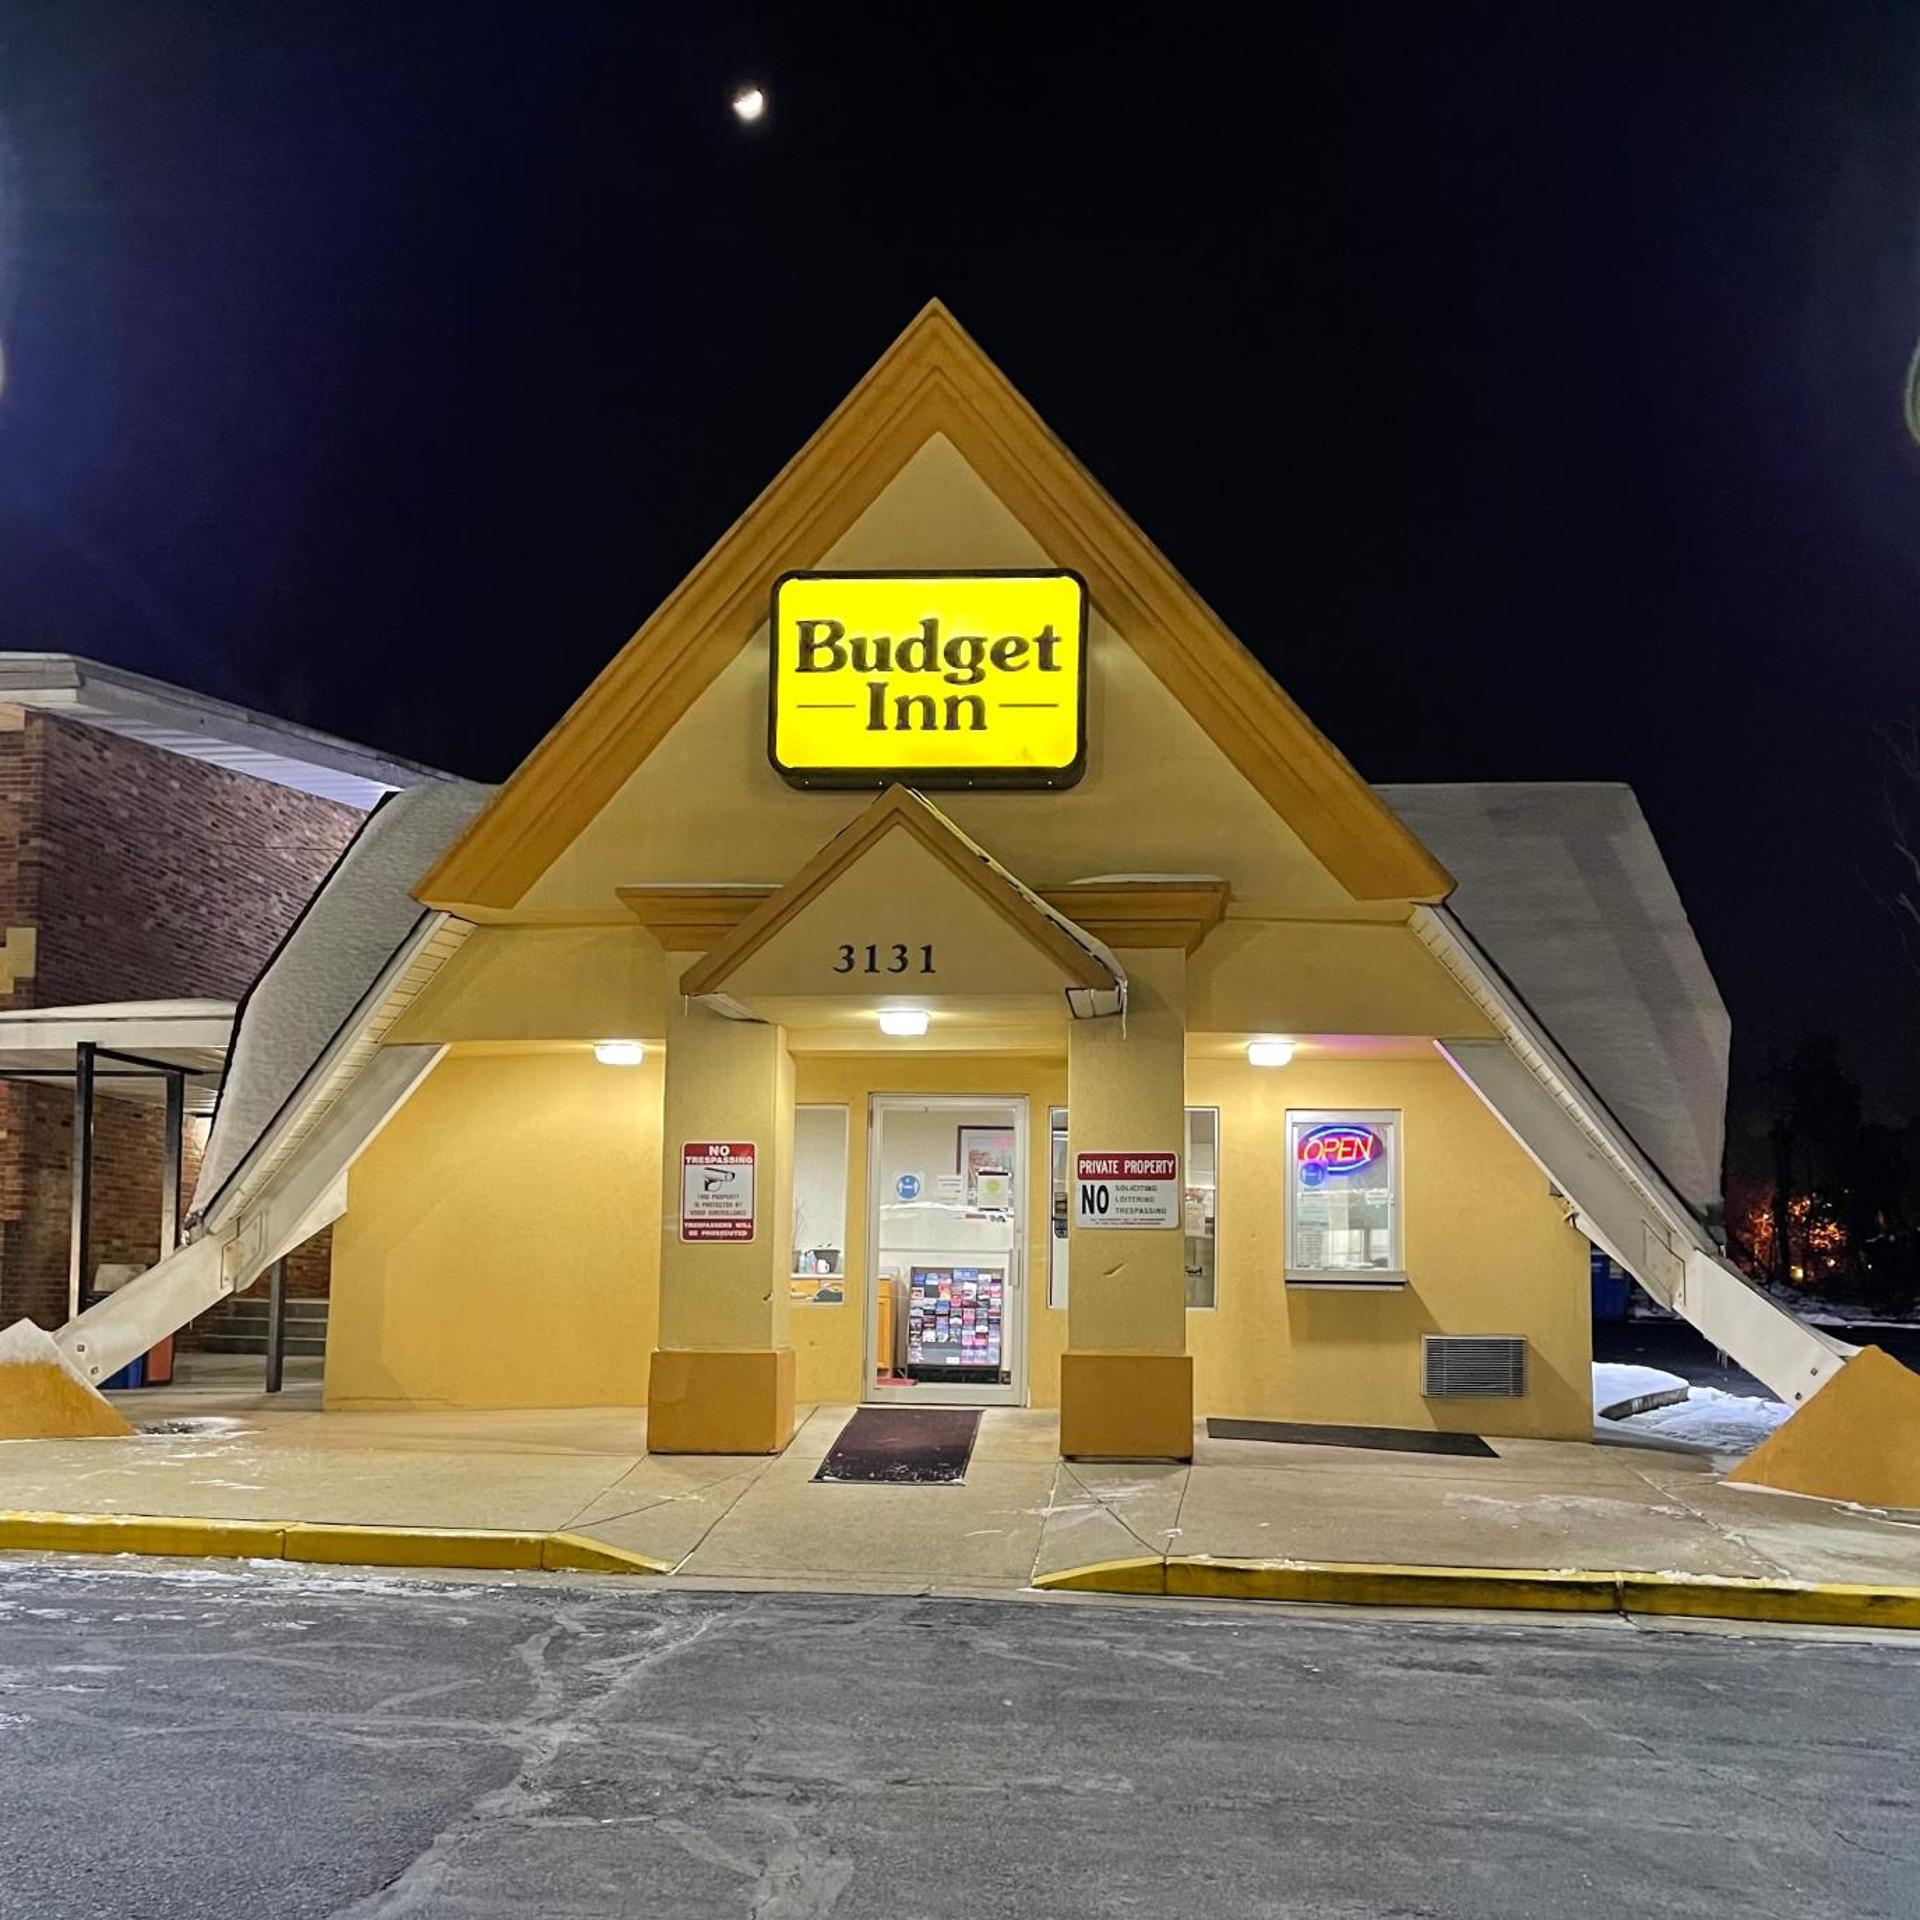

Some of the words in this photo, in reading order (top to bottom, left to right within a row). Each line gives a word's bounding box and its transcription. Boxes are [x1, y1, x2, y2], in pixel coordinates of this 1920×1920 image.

[795, 618, 1062, 685] Budget
[866, 682, 987, 730] Inn
[832, 944, 936, 973] 3131
[708, 1145, 730, 1157] NO
[1303, 1135, 1373, 1162] OPEN
[1079, 1160, 1119, 1175] PRIVATE
[1124, 1160, 1174, 1174] PROPERTY
[1081, 1184, 1109, 1215] NO
[1115, 1207, 1167, 1215] TRESPASSING
